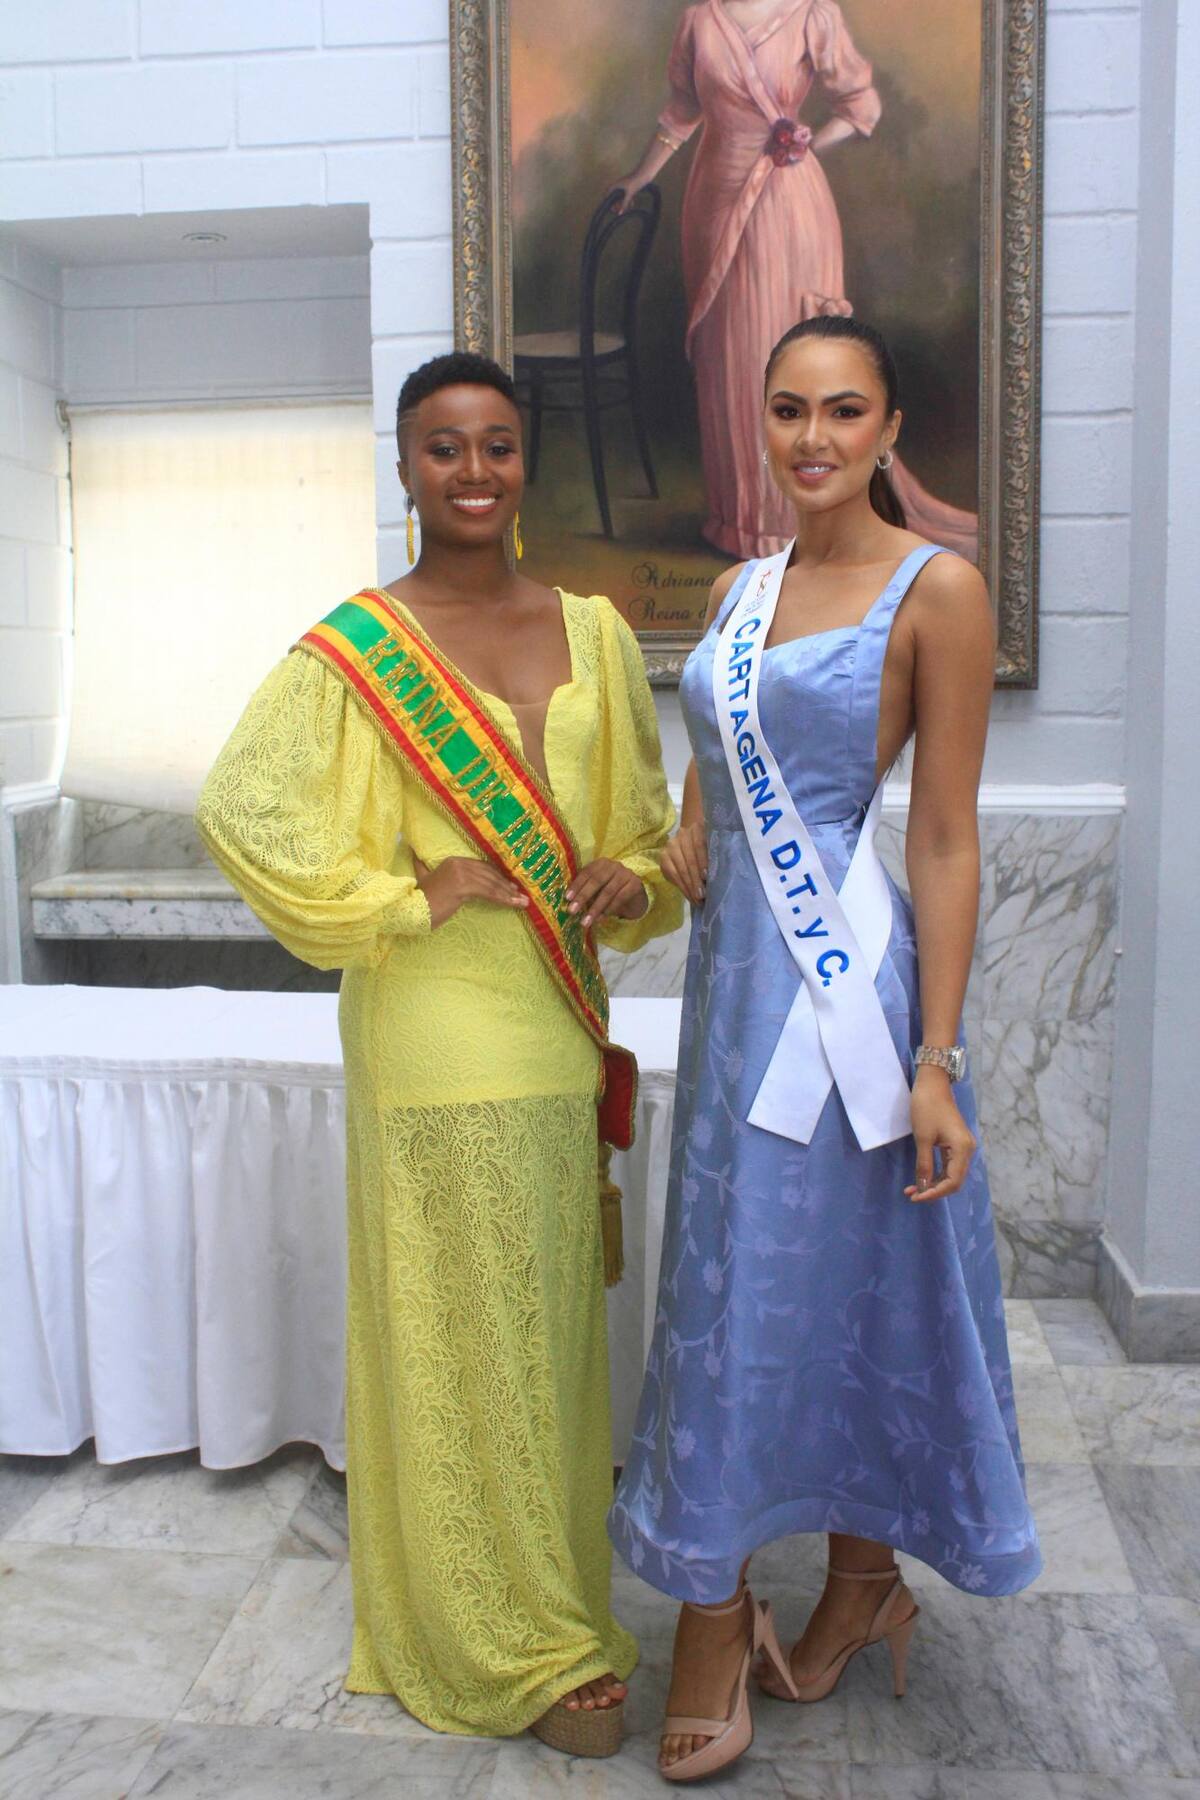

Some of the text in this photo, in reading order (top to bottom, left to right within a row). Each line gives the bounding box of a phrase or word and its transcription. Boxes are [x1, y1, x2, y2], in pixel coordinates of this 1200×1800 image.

[628, 595, 689, 621] Reina
[358, 626, 467, 760] REINA
[446, 745, 517, 820] DE
[728, 617, 784, 837] CARTAGENA
